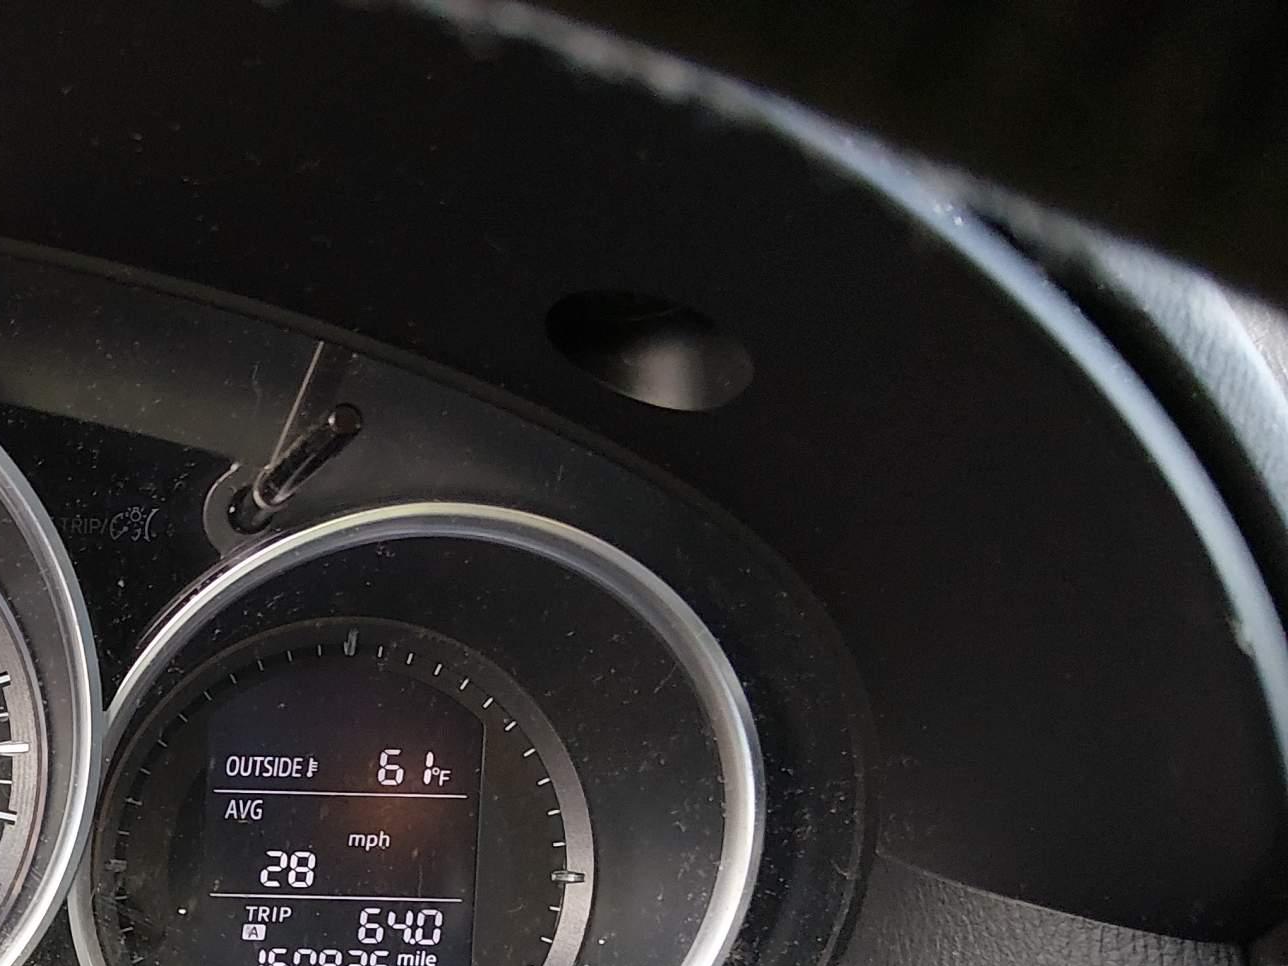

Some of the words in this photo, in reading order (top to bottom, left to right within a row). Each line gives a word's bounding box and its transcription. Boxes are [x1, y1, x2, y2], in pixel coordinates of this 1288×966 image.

[225, 755, 303, 778] OUTSIDE
[377, 749, 433, 786] 61
[224, 799, 264, 820] AVG
[348, 831, 392, 851] mph
[260, 850, 316, 888] 28
[245, 906, 292, 923] TRIP
